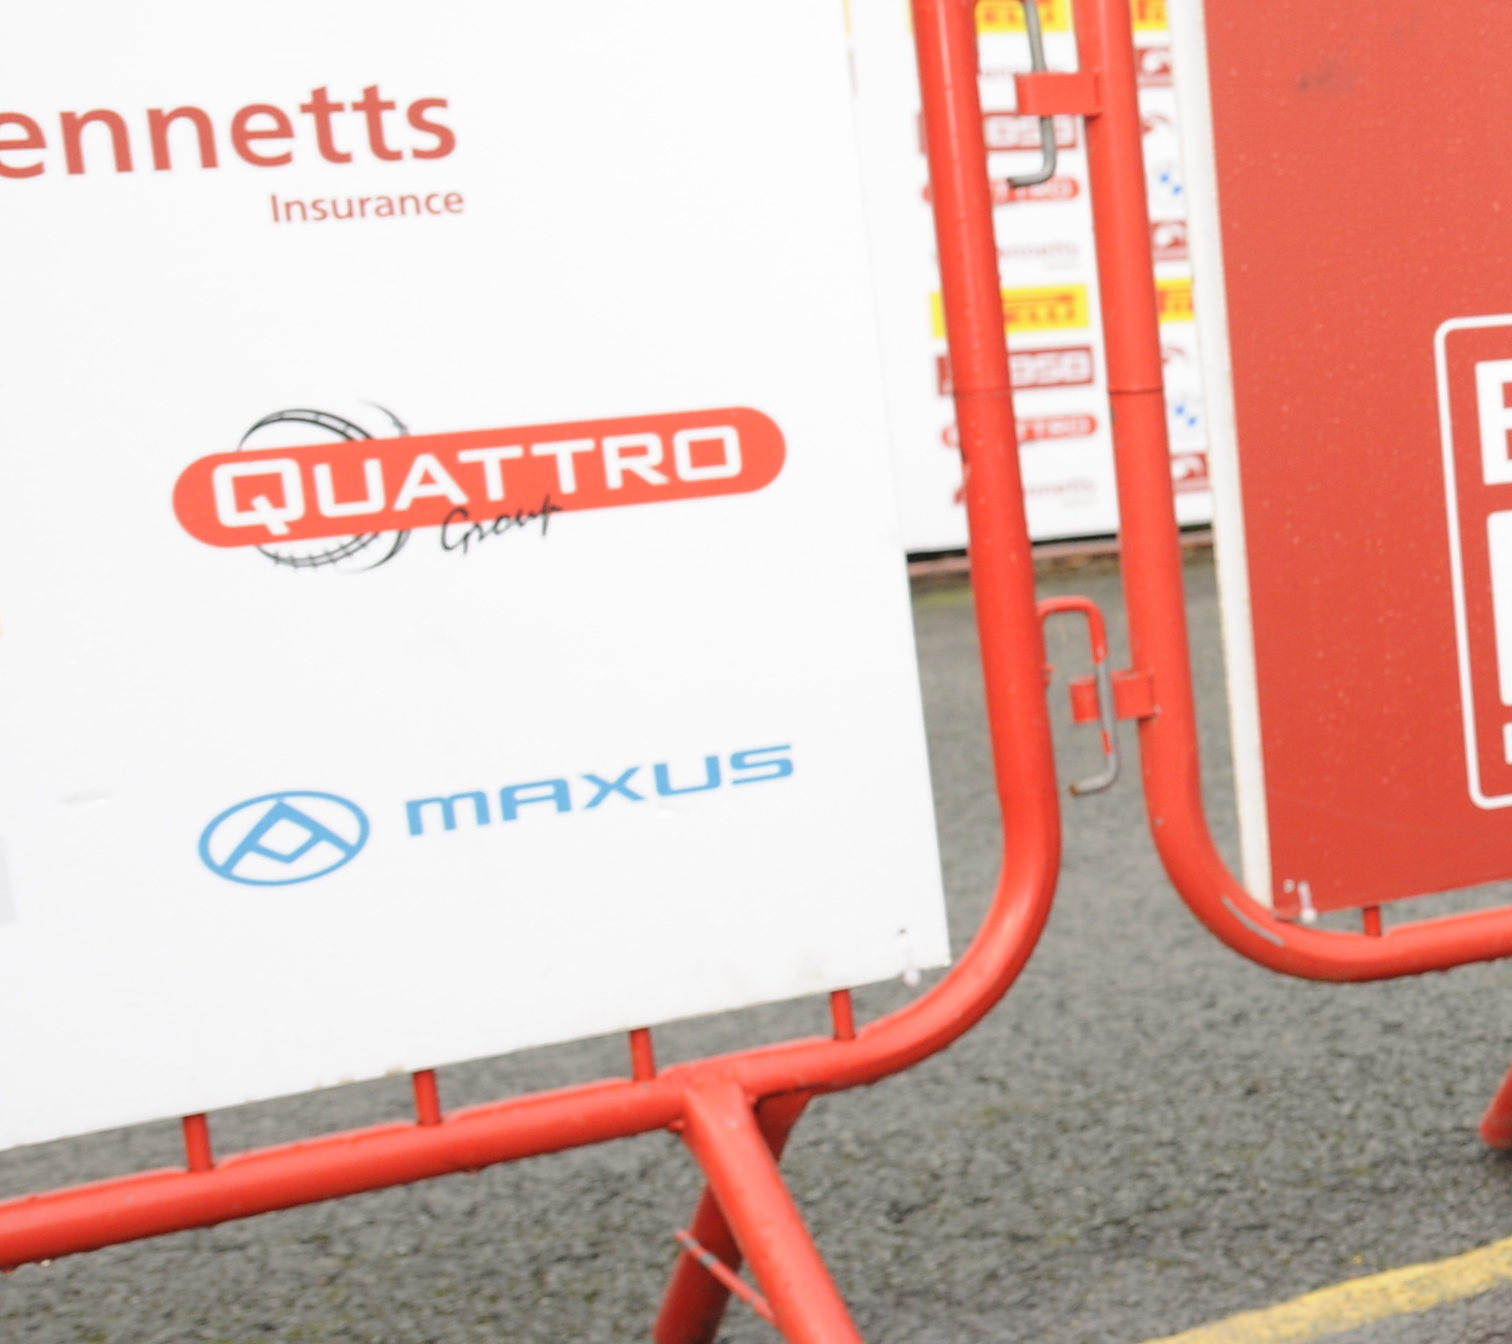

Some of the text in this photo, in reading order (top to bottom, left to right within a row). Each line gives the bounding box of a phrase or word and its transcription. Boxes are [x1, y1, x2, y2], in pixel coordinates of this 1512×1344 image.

[270, 188, 465, 224] Insurance
[211, 425, 743, 536] QUATTRO
[439, 496, 563, 556] Group
[405, 743, 796, 836] MAXUS
